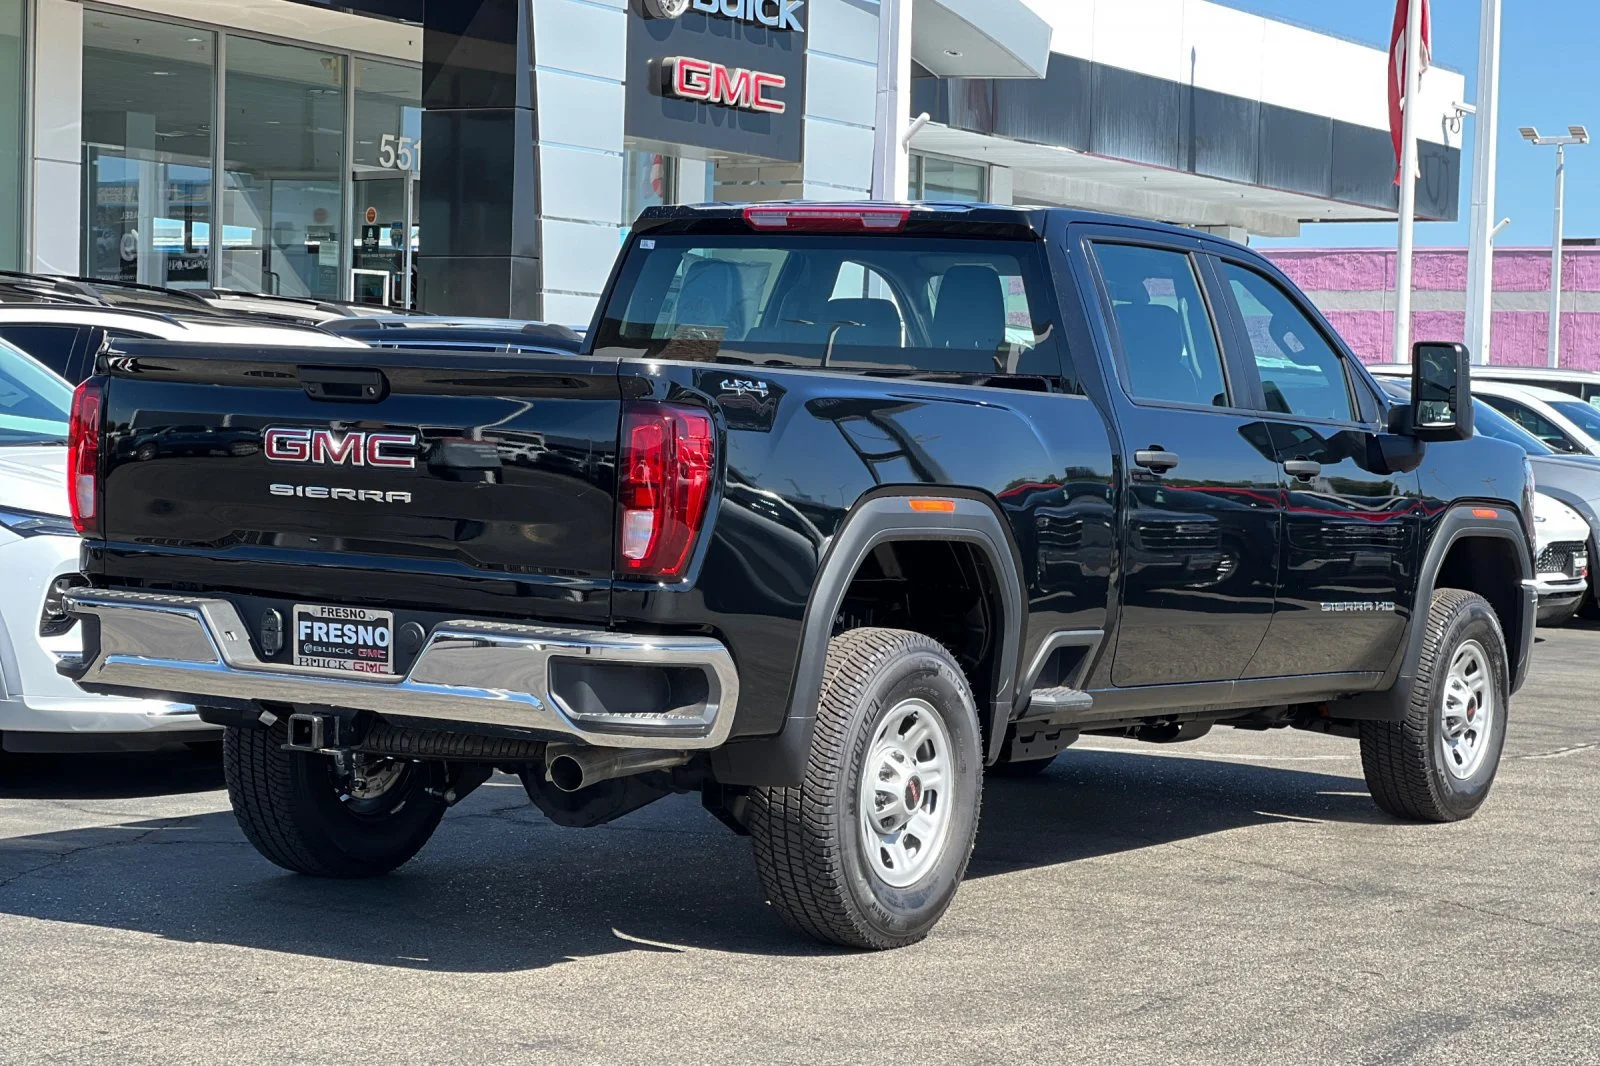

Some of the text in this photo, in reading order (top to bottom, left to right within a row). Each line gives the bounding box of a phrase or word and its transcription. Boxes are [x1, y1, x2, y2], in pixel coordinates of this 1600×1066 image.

[674, 56, 786, 113] GMC
[264, 428, 416, 469] GMC
[269, 483, 412, 503] SIERRA
[320, 606, 366, 619] FRESNO
[1320, 601, 1395, 611] SIERRA HD
[300, 621, 389, 647] FRESNO
[313, 646, 386, 658] BUICK GMC
[299, 657, 389, 674] BUICK GMC
